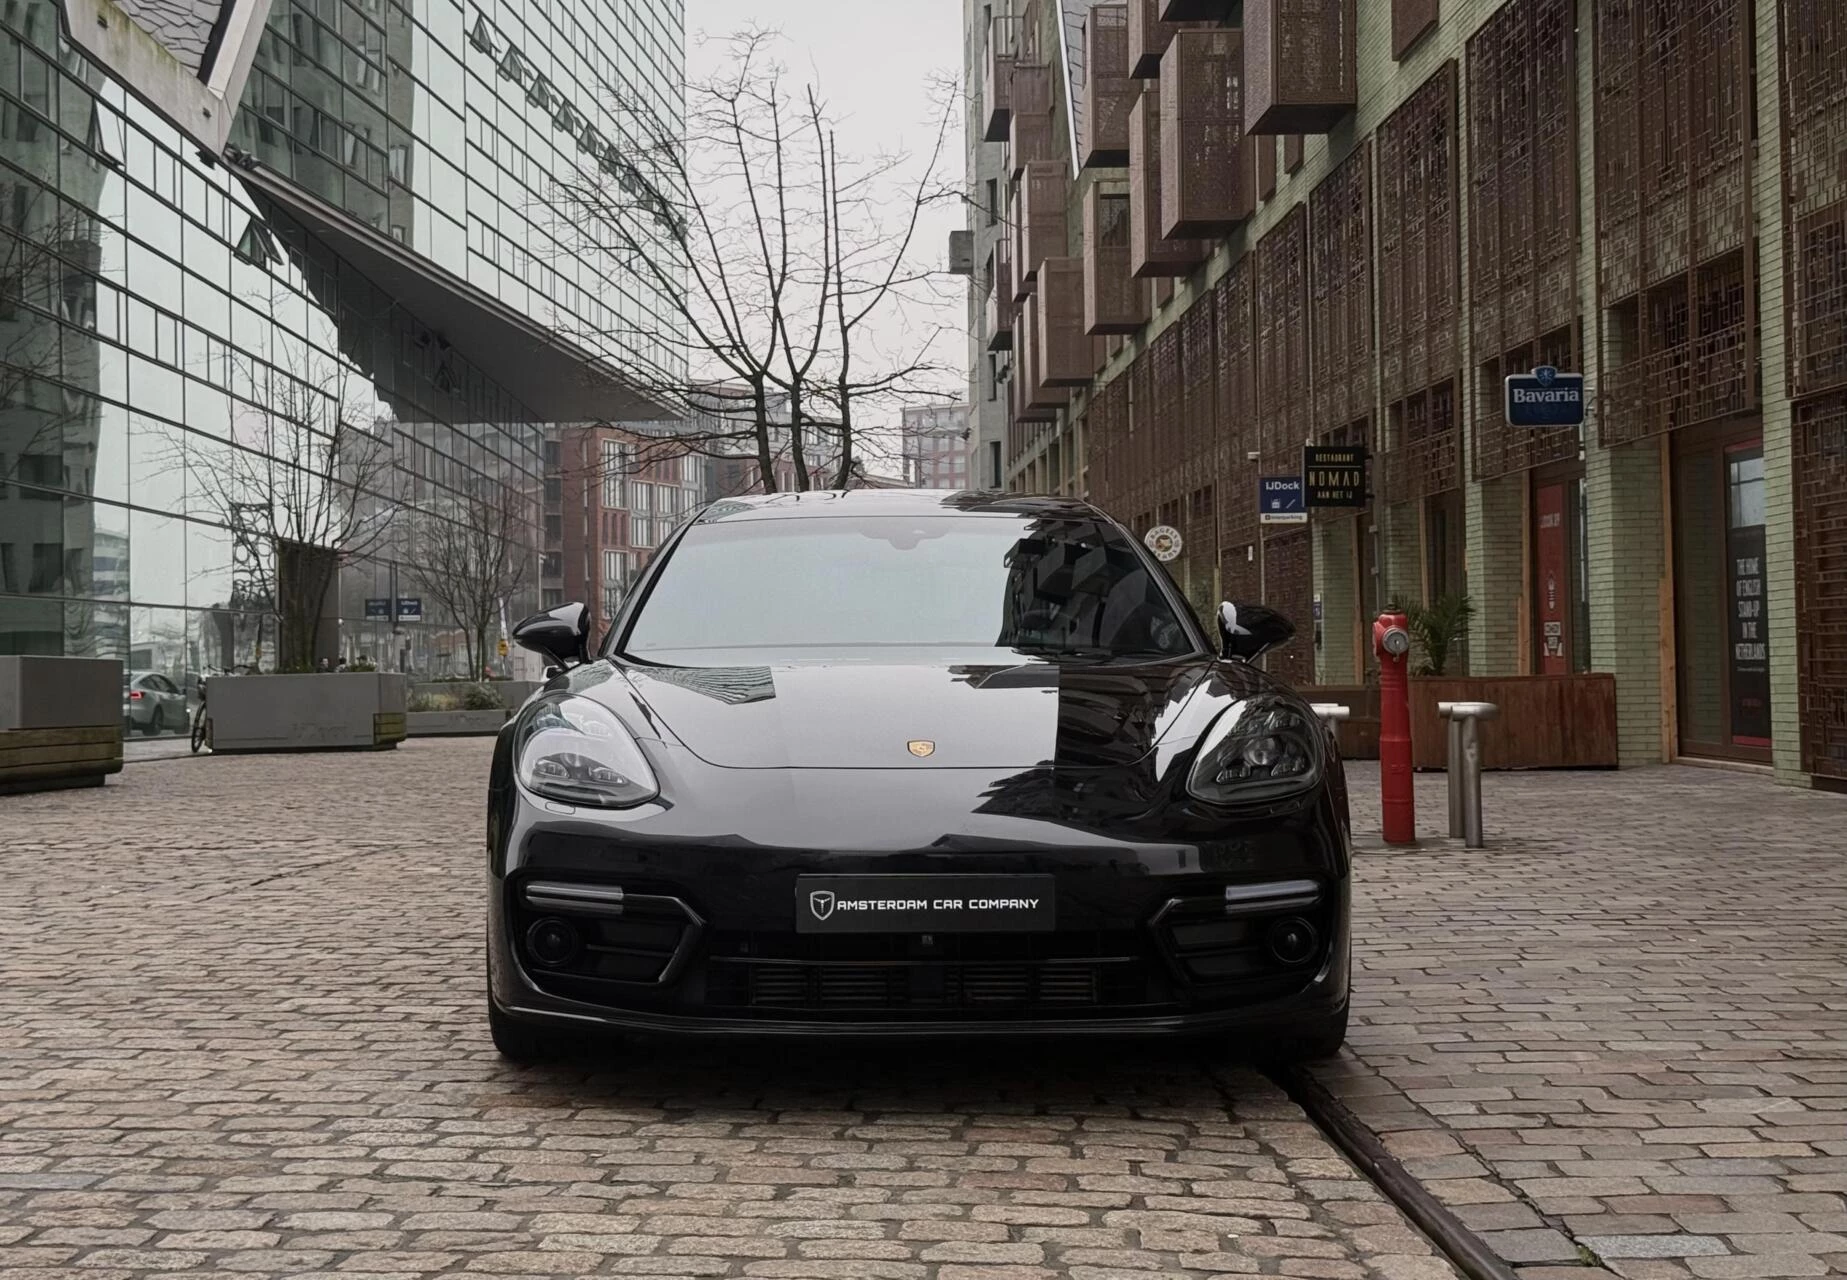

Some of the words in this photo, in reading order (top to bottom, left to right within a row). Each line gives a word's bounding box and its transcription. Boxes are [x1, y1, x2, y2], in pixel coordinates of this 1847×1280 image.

[1513, 387, 1579, 403] Bavaria
[1315, 453, 1354, 462] RESTAURANT
[1309, 471, 1360, 487] NOMAD
[1265, 481, 1300, 490] IJDock
[1317, 490, 1330, 499] AAN
[1332, 490, 1344, 499] HET
[837, 900, 928, 910] AMSTERDAM
[933, 899, 963, 910] CAR
[968, 899, 1039, 909] COMPANY
